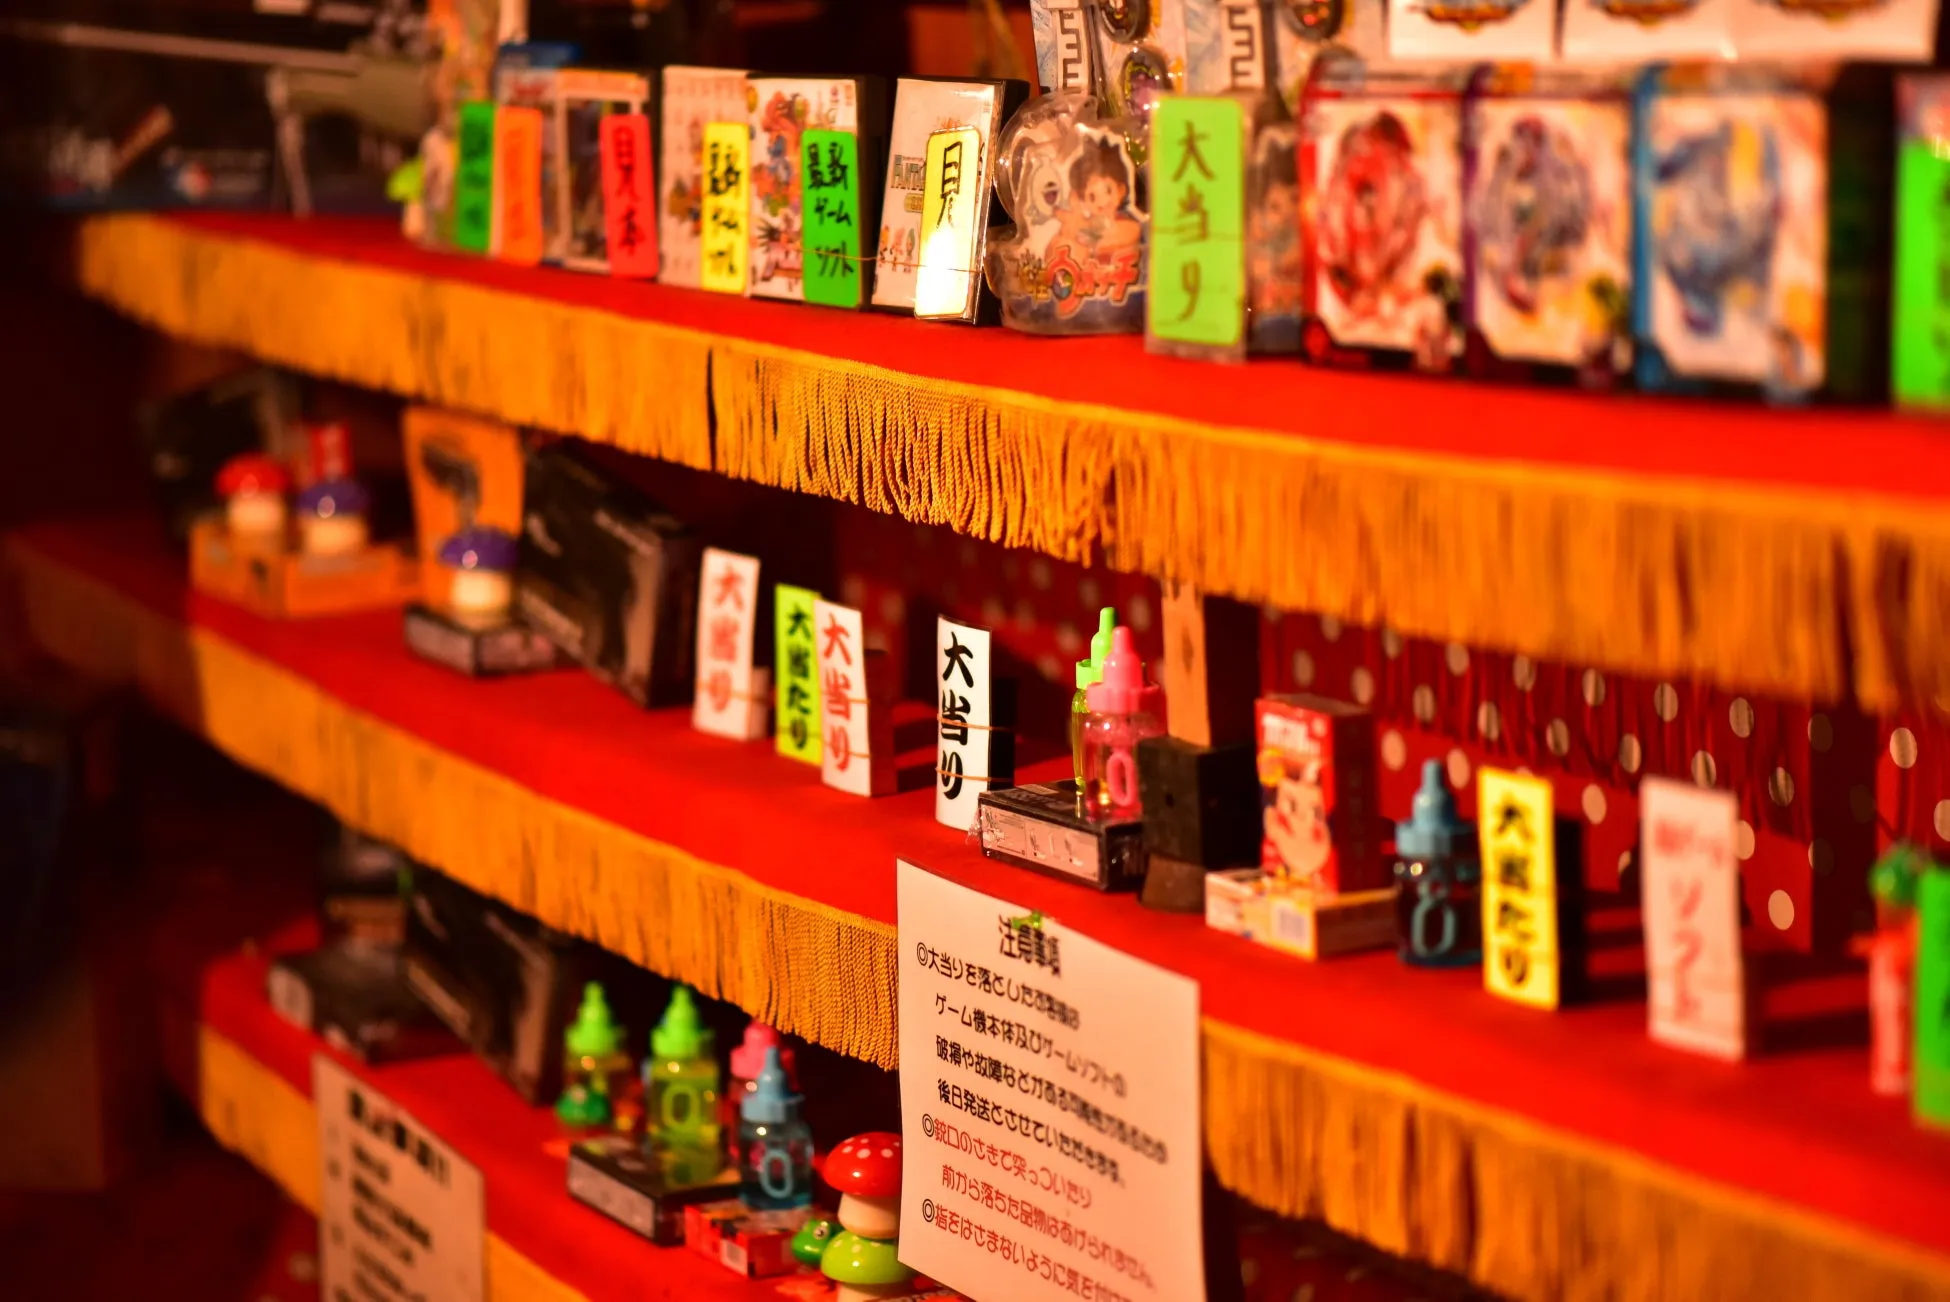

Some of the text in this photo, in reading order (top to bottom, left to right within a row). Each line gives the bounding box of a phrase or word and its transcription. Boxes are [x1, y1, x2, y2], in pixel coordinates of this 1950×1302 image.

[814, 197, 852, 227] ゲーム
[814, 240, 854, 279] ソフト
[1171, 118, 1217, 323] 大当り
[822, 611, 853, 773] 大当り
[940, 631, 975, 801] 大当り
[933, 1117, 1093, 1209] 銃口のさきで突っついたり
